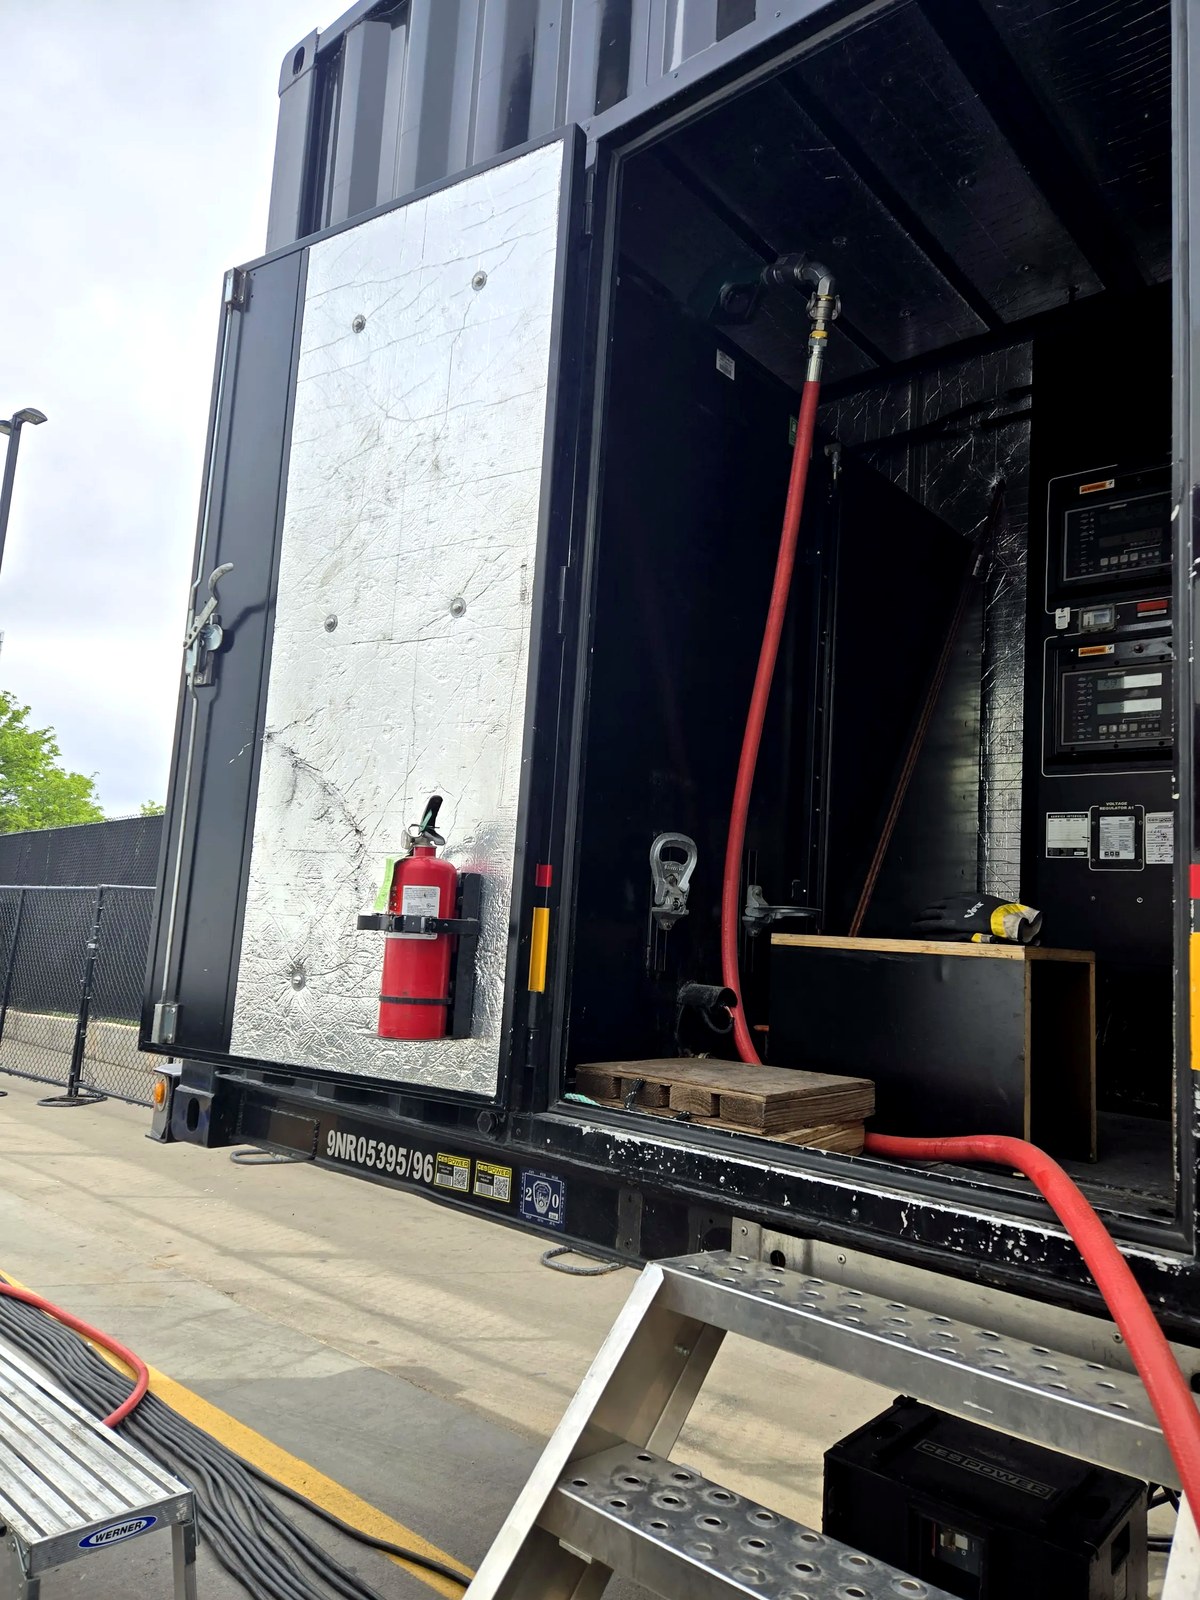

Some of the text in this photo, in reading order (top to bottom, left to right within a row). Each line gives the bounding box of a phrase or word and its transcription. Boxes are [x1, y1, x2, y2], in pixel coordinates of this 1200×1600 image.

[326, 1129, 434, 1183] 9NR05395/96
[448, 1157, 469, 1168] POWER
[488, 1165, 510, 1177] POWER
[525, 1187, 559, 1209] 2 0
[920, 1442, 1052, 1498] CES POWER
[95, 1520, 143, 1543] WERNER
